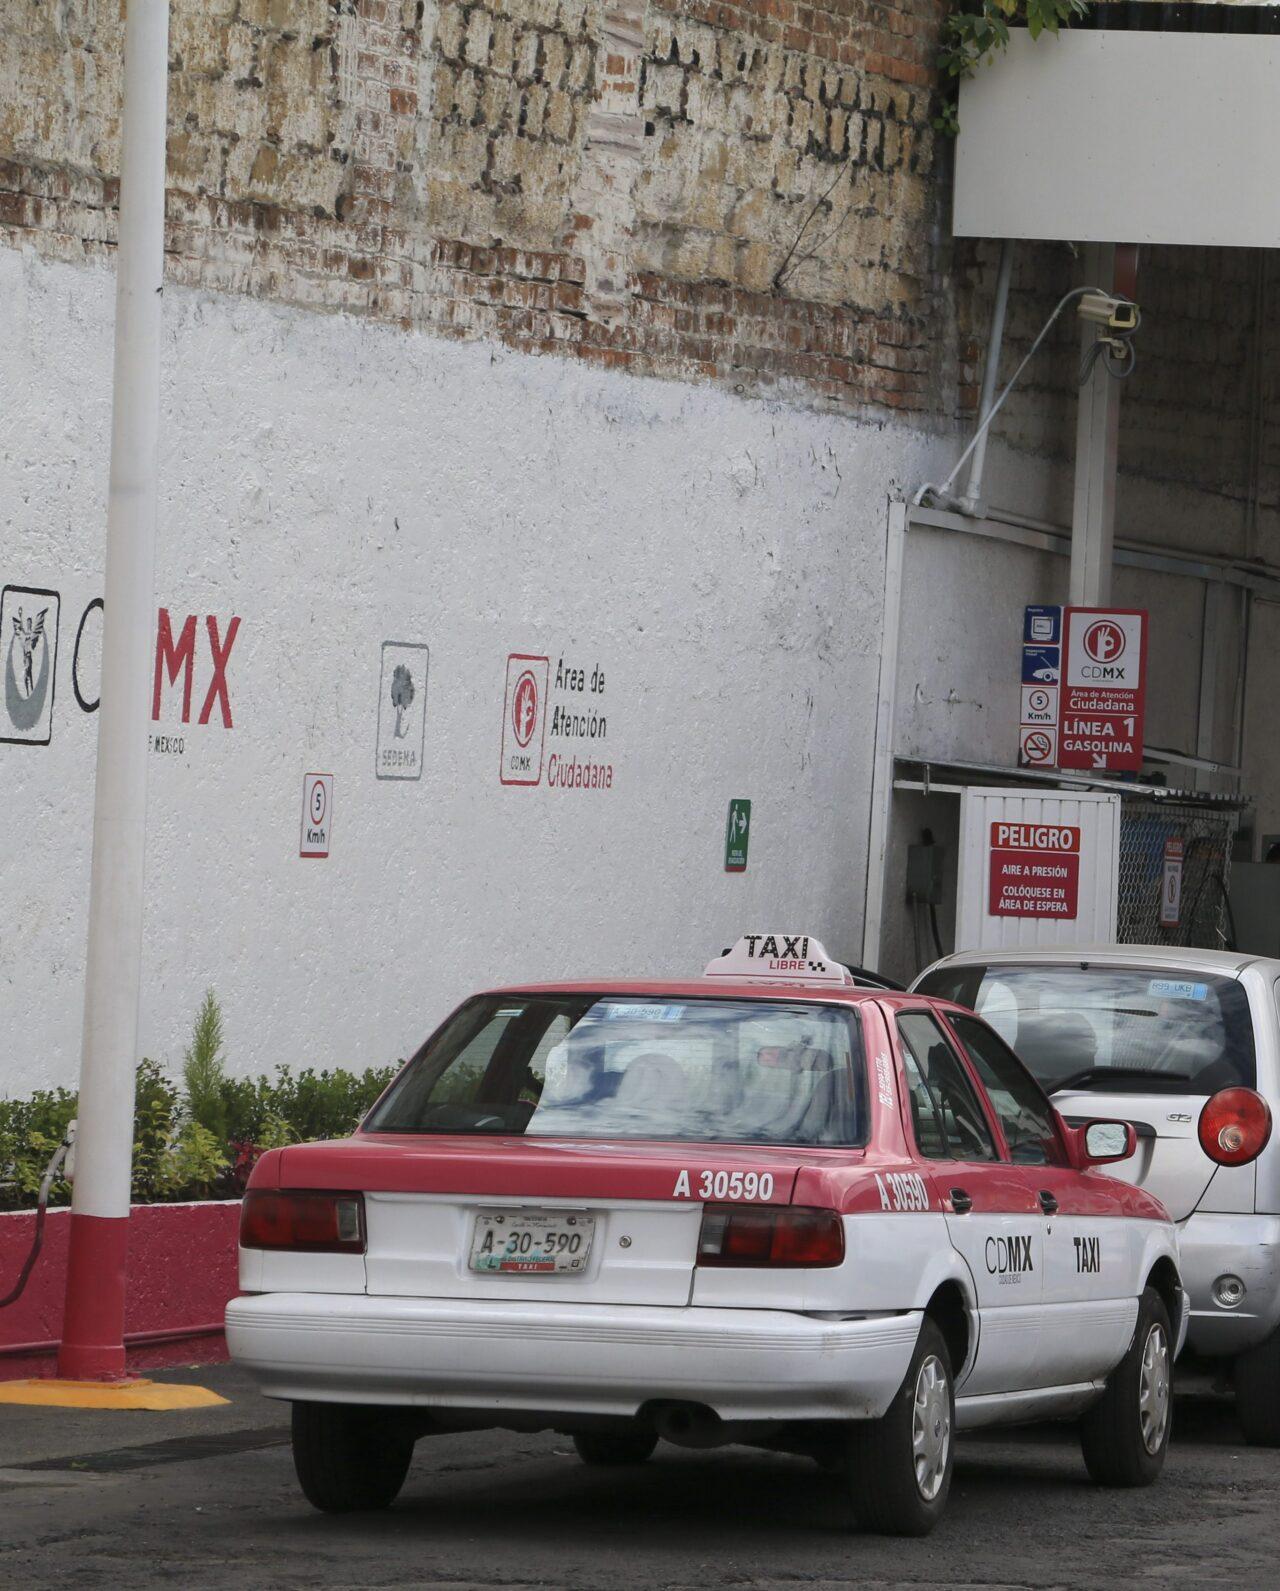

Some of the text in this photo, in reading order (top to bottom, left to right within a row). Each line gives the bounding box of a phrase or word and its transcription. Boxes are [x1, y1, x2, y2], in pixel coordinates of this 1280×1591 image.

[73, 597, 242, 729] CMX
[554, 650, 606, 694] Área de
[1080, 665, 1126, 680] CDMX
[1036, 695, 1043, 705] 5
[1071, 689, 1134, 699] Área de Atención
[1069, 697, 1135, 711] Ciudadana
[550, 704, 608, 738] Atención
[1027, 711, 1051, 721] Km/h
[1063, 716, 1135, 737] LÍNEA 1
[1063, 739, 1133, 754] GASOLINA
[381, 749, 417, 767] SEDEMA
[510, 755, 531, 771] CDMX
[547, 754, 613, 789] Ciudadana
[315, 792, 321, 811] 5
[306, 828, 326, 844] Km/h
[998, 825, 1074, 849] PELIGRO
[1001, 864, 1068, 878] AIRE A PRESIÓN
[1002, 884, 1065, 898] COLÓQUESE EN
[999, 898, 1068, 912] ÁREA DE ESPERA
[744, 935, 809, 959] TAXI
[769, 960, 805, 970] LIBRE
[673, 1169, 774, 1201] A 30590
[874, 1173, 930, 1211] A 30590
[480, 1230, 582, 1254] A-30-590
[984, 1235, 1100, 1274] CDMX TAXI
